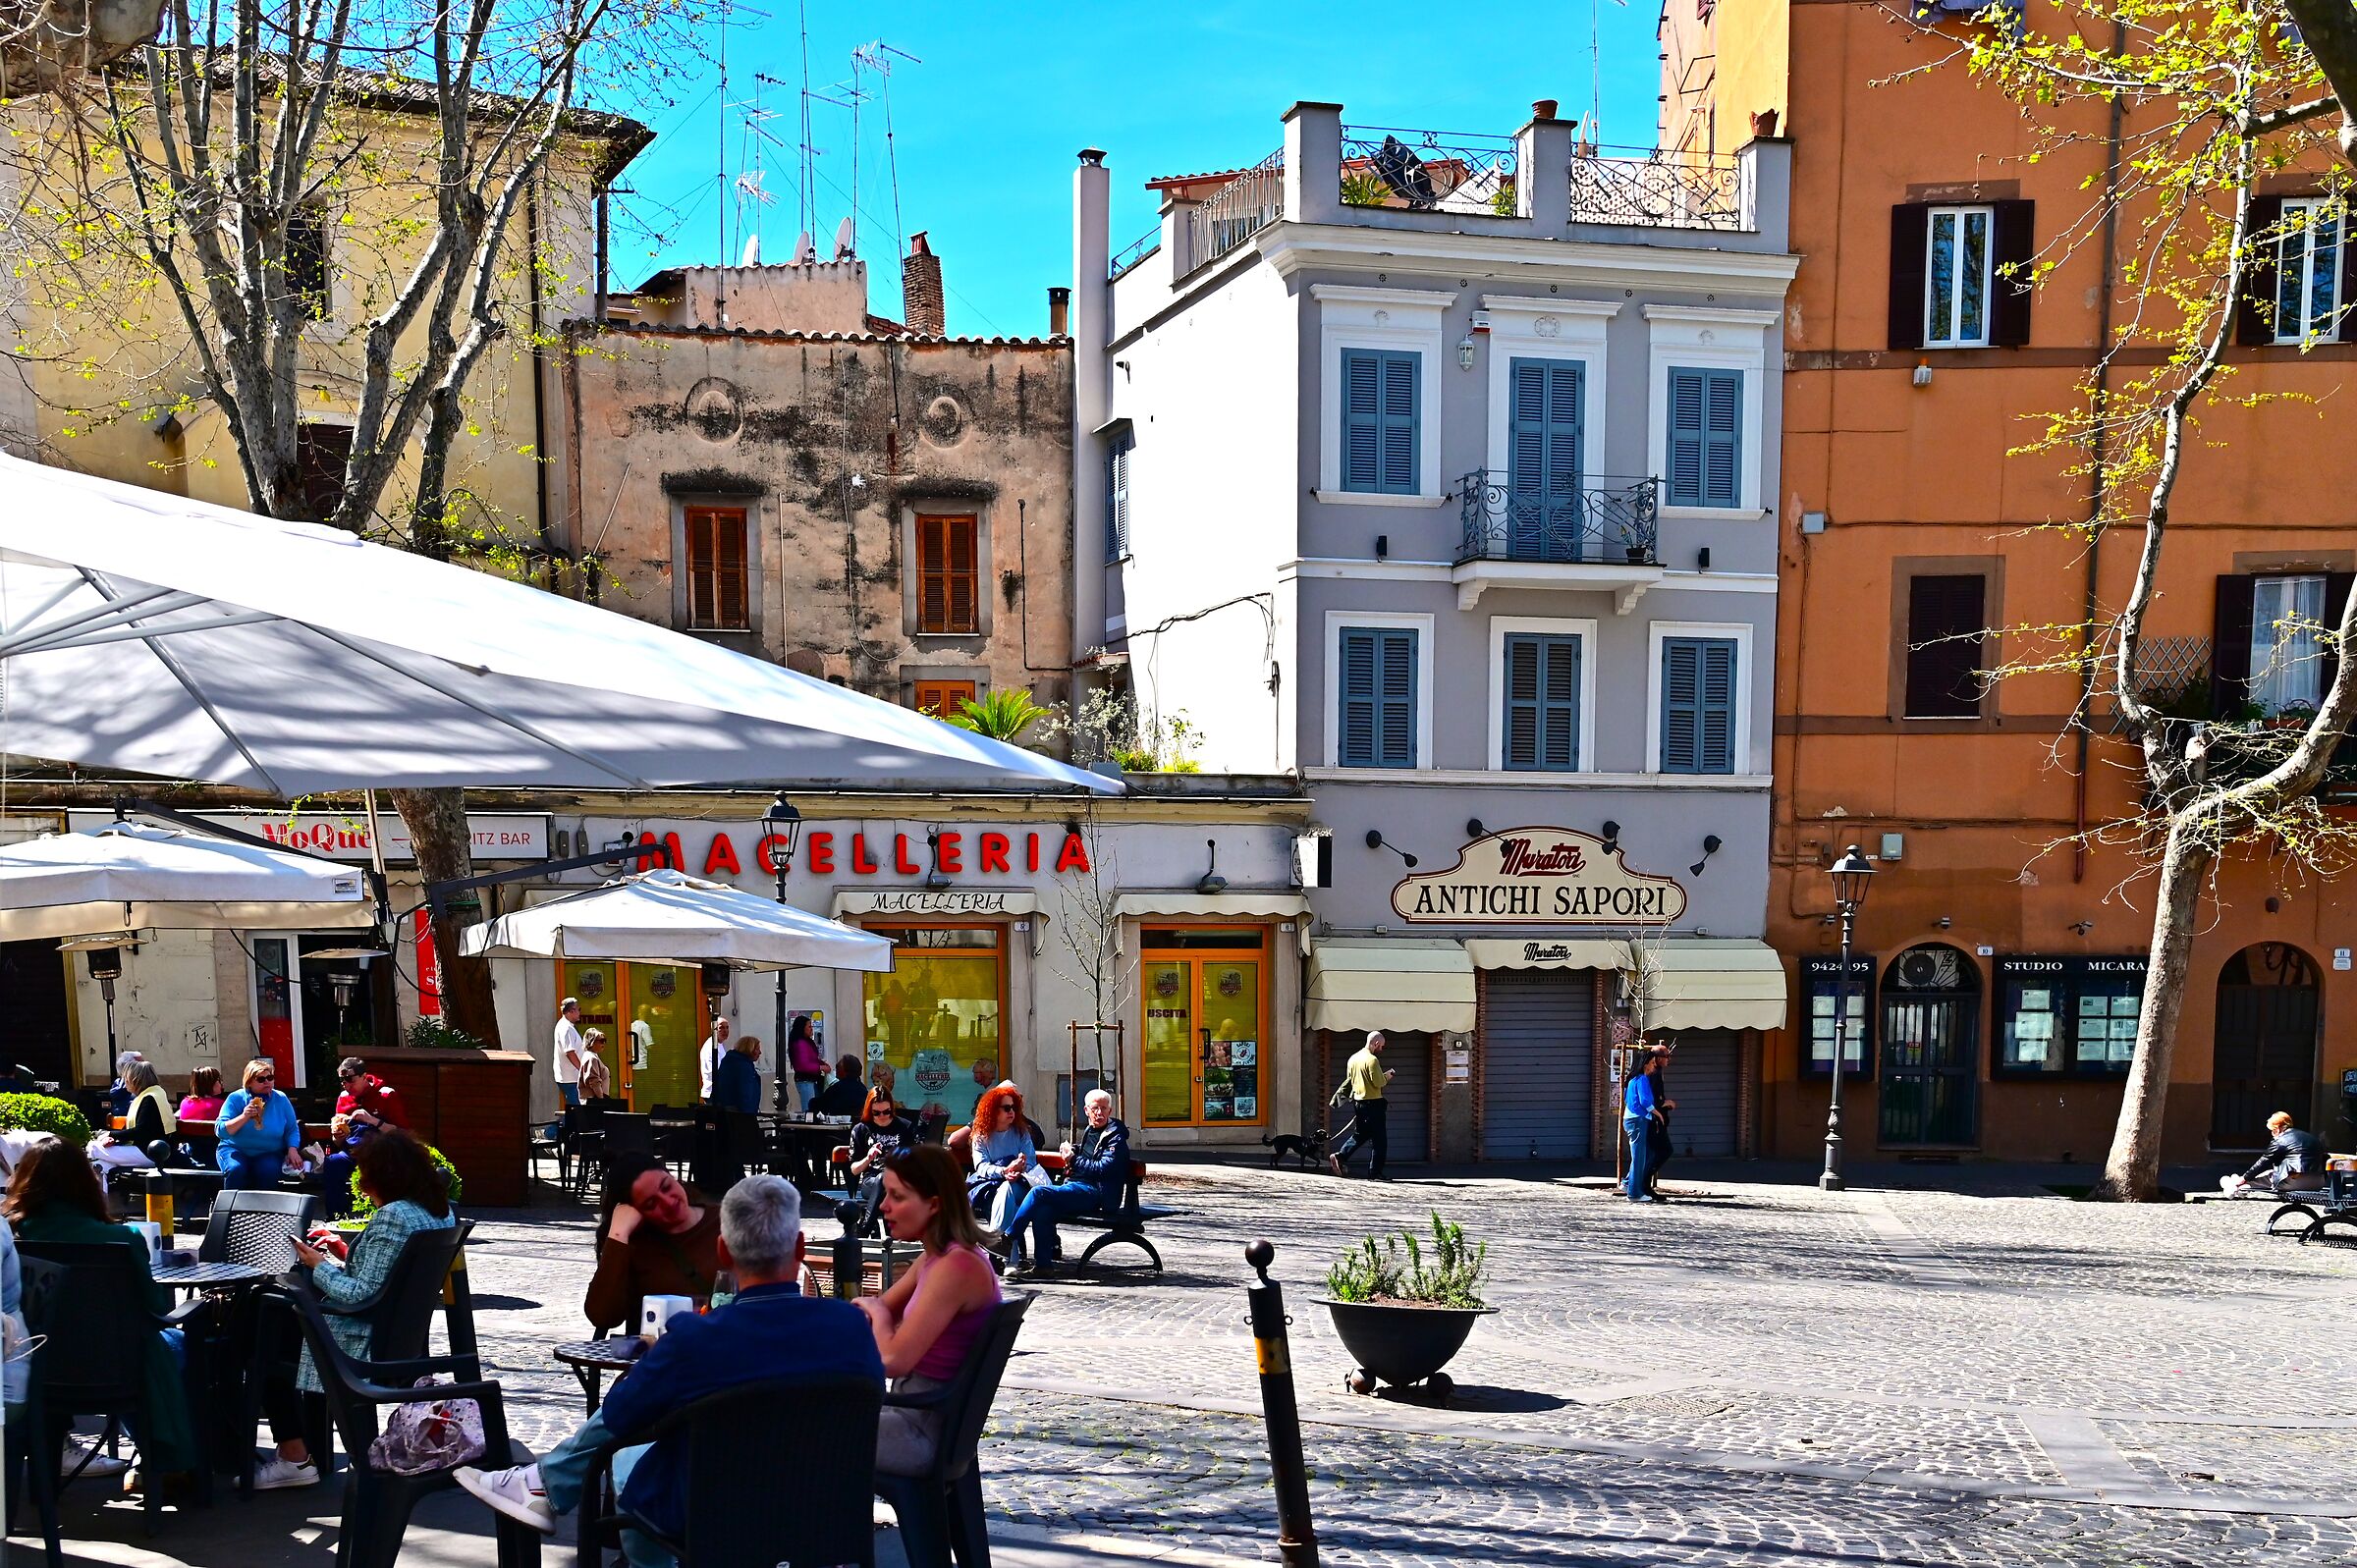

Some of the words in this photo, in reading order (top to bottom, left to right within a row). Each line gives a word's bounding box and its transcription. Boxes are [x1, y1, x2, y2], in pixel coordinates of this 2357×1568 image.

[469, 833, 494, 845] ITZ
[501, 833, 530, 845] BAR
[637, 832, 1092, 875] MACELLERIA
[1500, 838, 1586, 877] Muratori
[871, 893, 1005, 910] MACELLERIA
[1414, 885, 1541, 914] ANTICHI
[1554, 887, 1667, 915] SAPORI
[1524, 943, 1571, 961] Muratori
[2003, 961, 2063, 971] STUDIO
[2088, 961, 2146, 971] MICARA
[1147, 1008, 1186, 1018] USCITA
